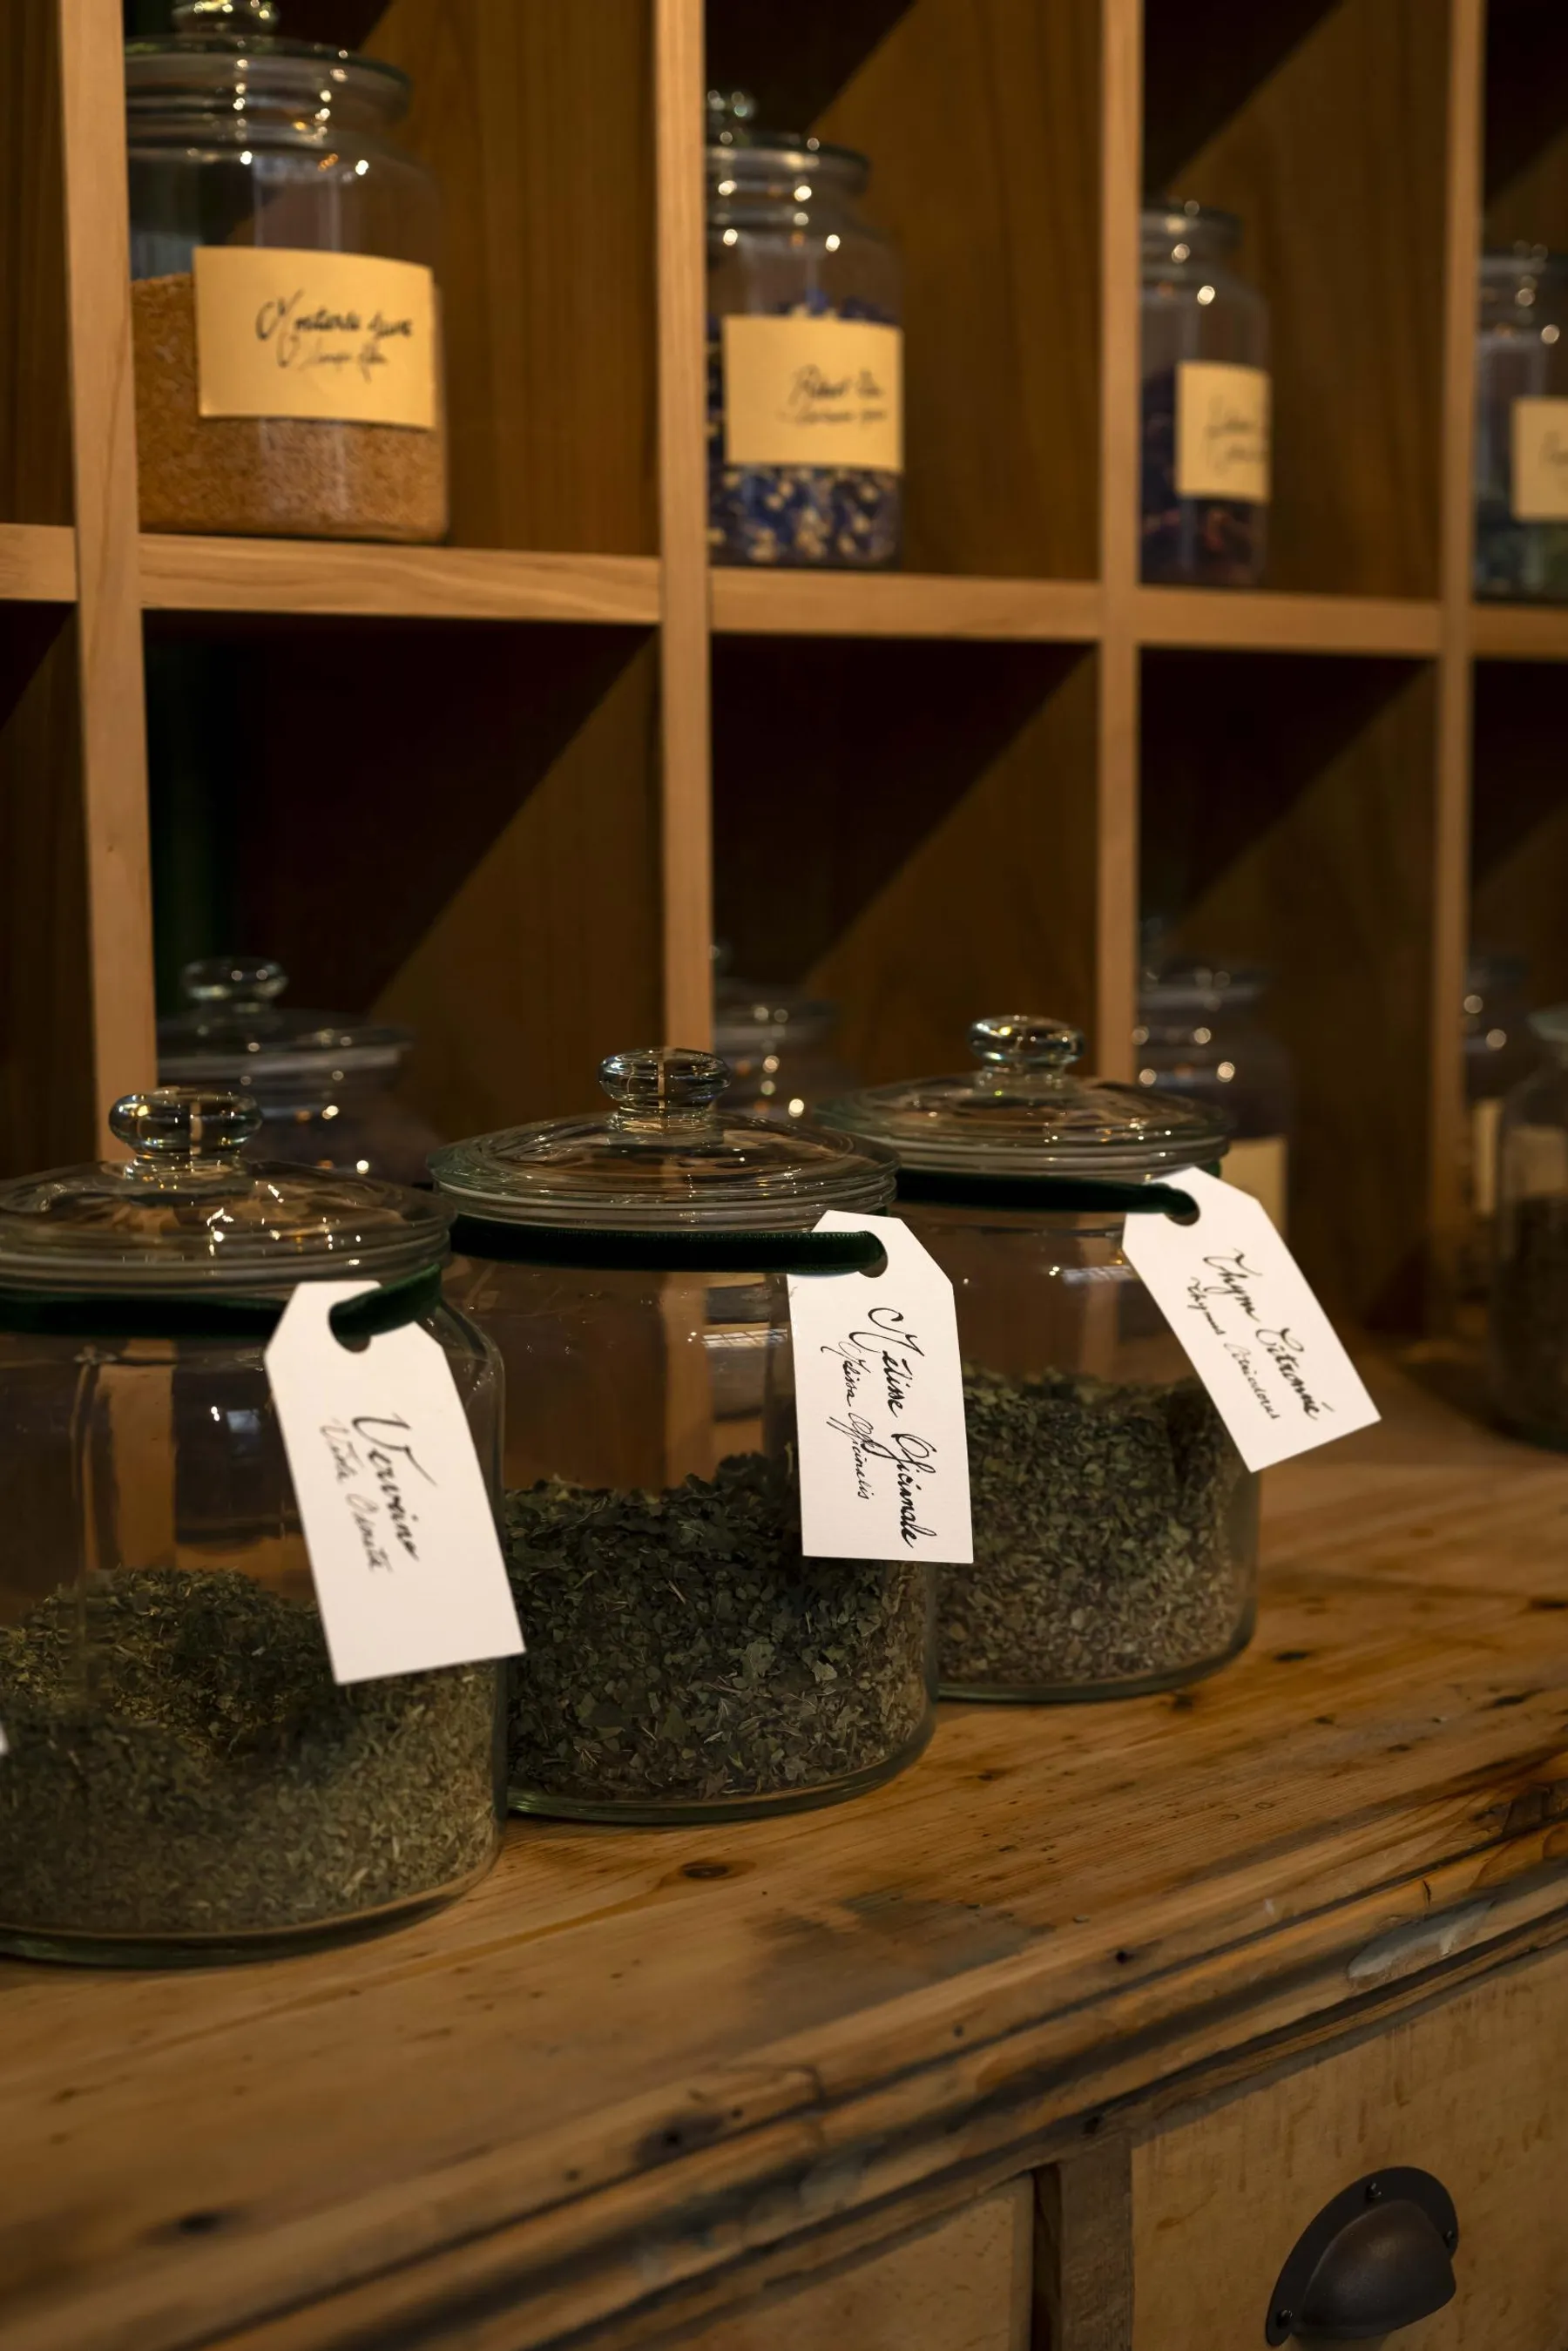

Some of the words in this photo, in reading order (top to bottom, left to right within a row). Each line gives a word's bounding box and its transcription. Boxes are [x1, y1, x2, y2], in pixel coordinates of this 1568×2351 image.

[1202, 1247, 1262, 1335] Thym
[821, 1341, 871, 1408] Melissa
[848, 1307, 925, 1419] Mélisse
[826, 1411, 877, 1500] Officinalis
